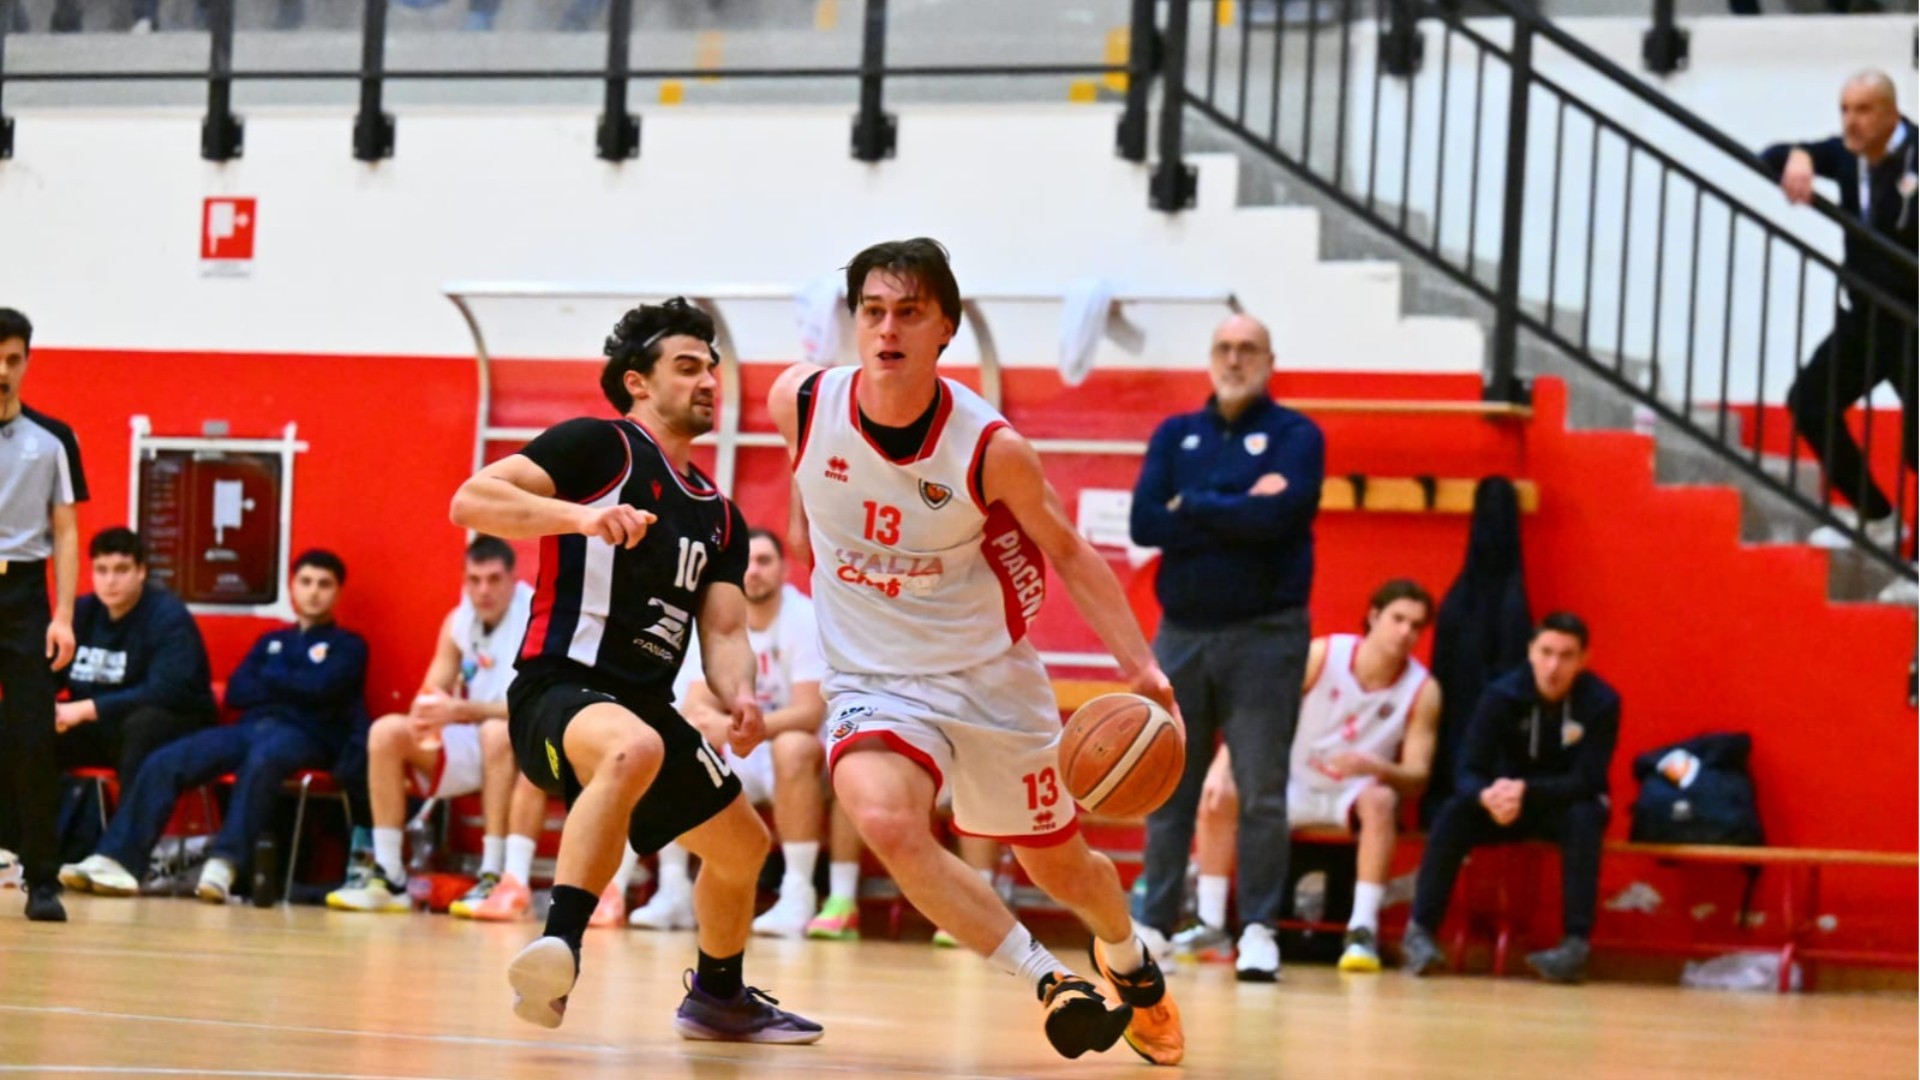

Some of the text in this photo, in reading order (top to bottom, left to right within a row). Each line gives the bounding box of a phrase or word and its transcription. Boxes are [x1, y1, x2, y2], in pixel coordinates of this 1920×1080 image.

[864, 501, 902, 546] 13
[674, 536, 708, 592] 10
[991, 529, 1044, 622] PIACEN
[1022, 766, 1058, 810] 13
